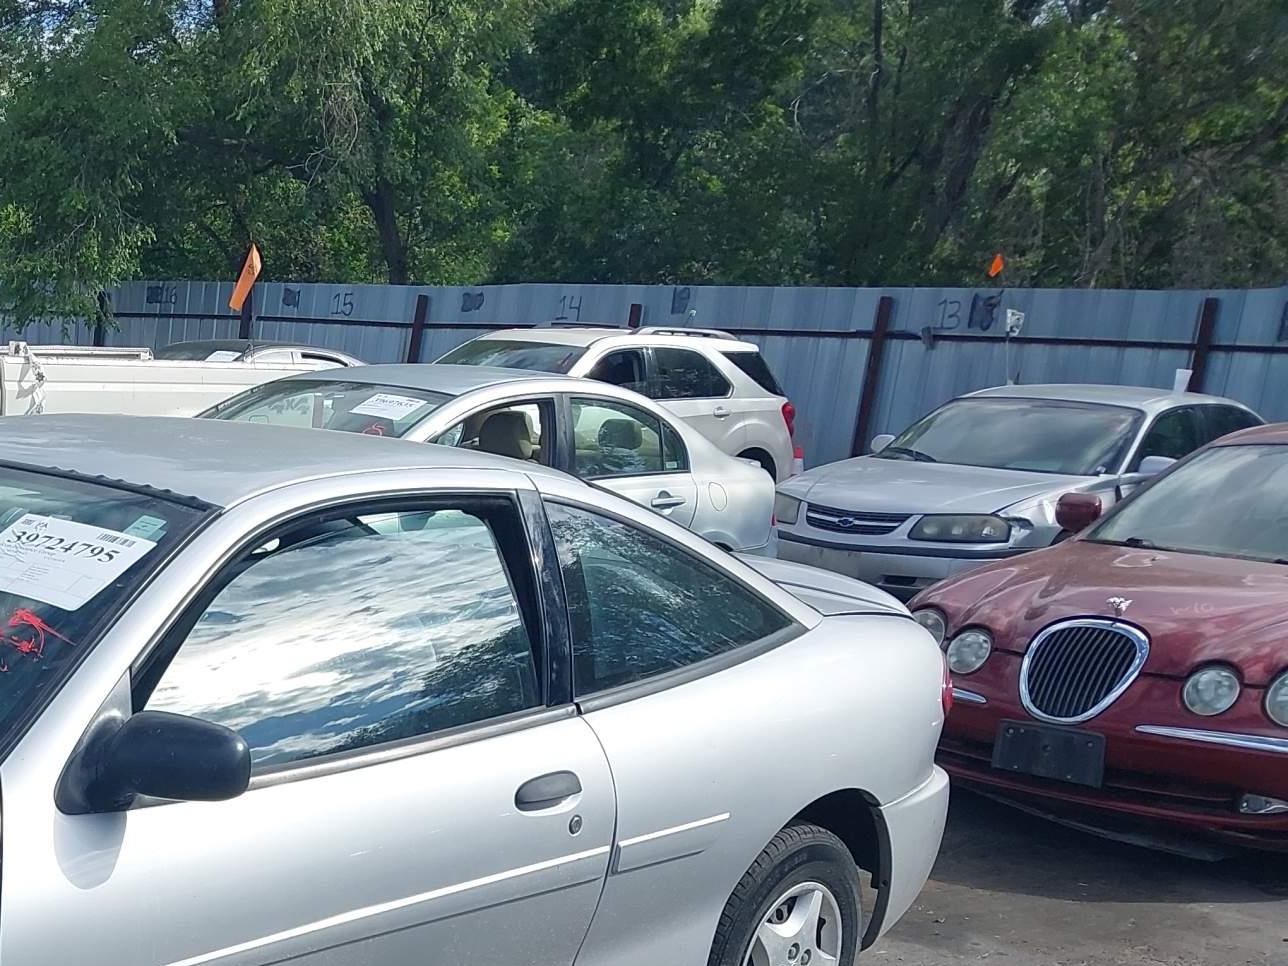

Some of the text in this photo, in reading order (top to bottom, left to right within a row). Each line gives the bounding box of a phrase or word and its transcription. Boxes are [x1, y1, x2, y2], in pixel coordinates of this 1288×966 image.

[331, 292, 354, 316] 15
[555, 295, 583, 322] 14
[933, 299, 961, 329] 13
[6, 529, 120, 563] 39724795
